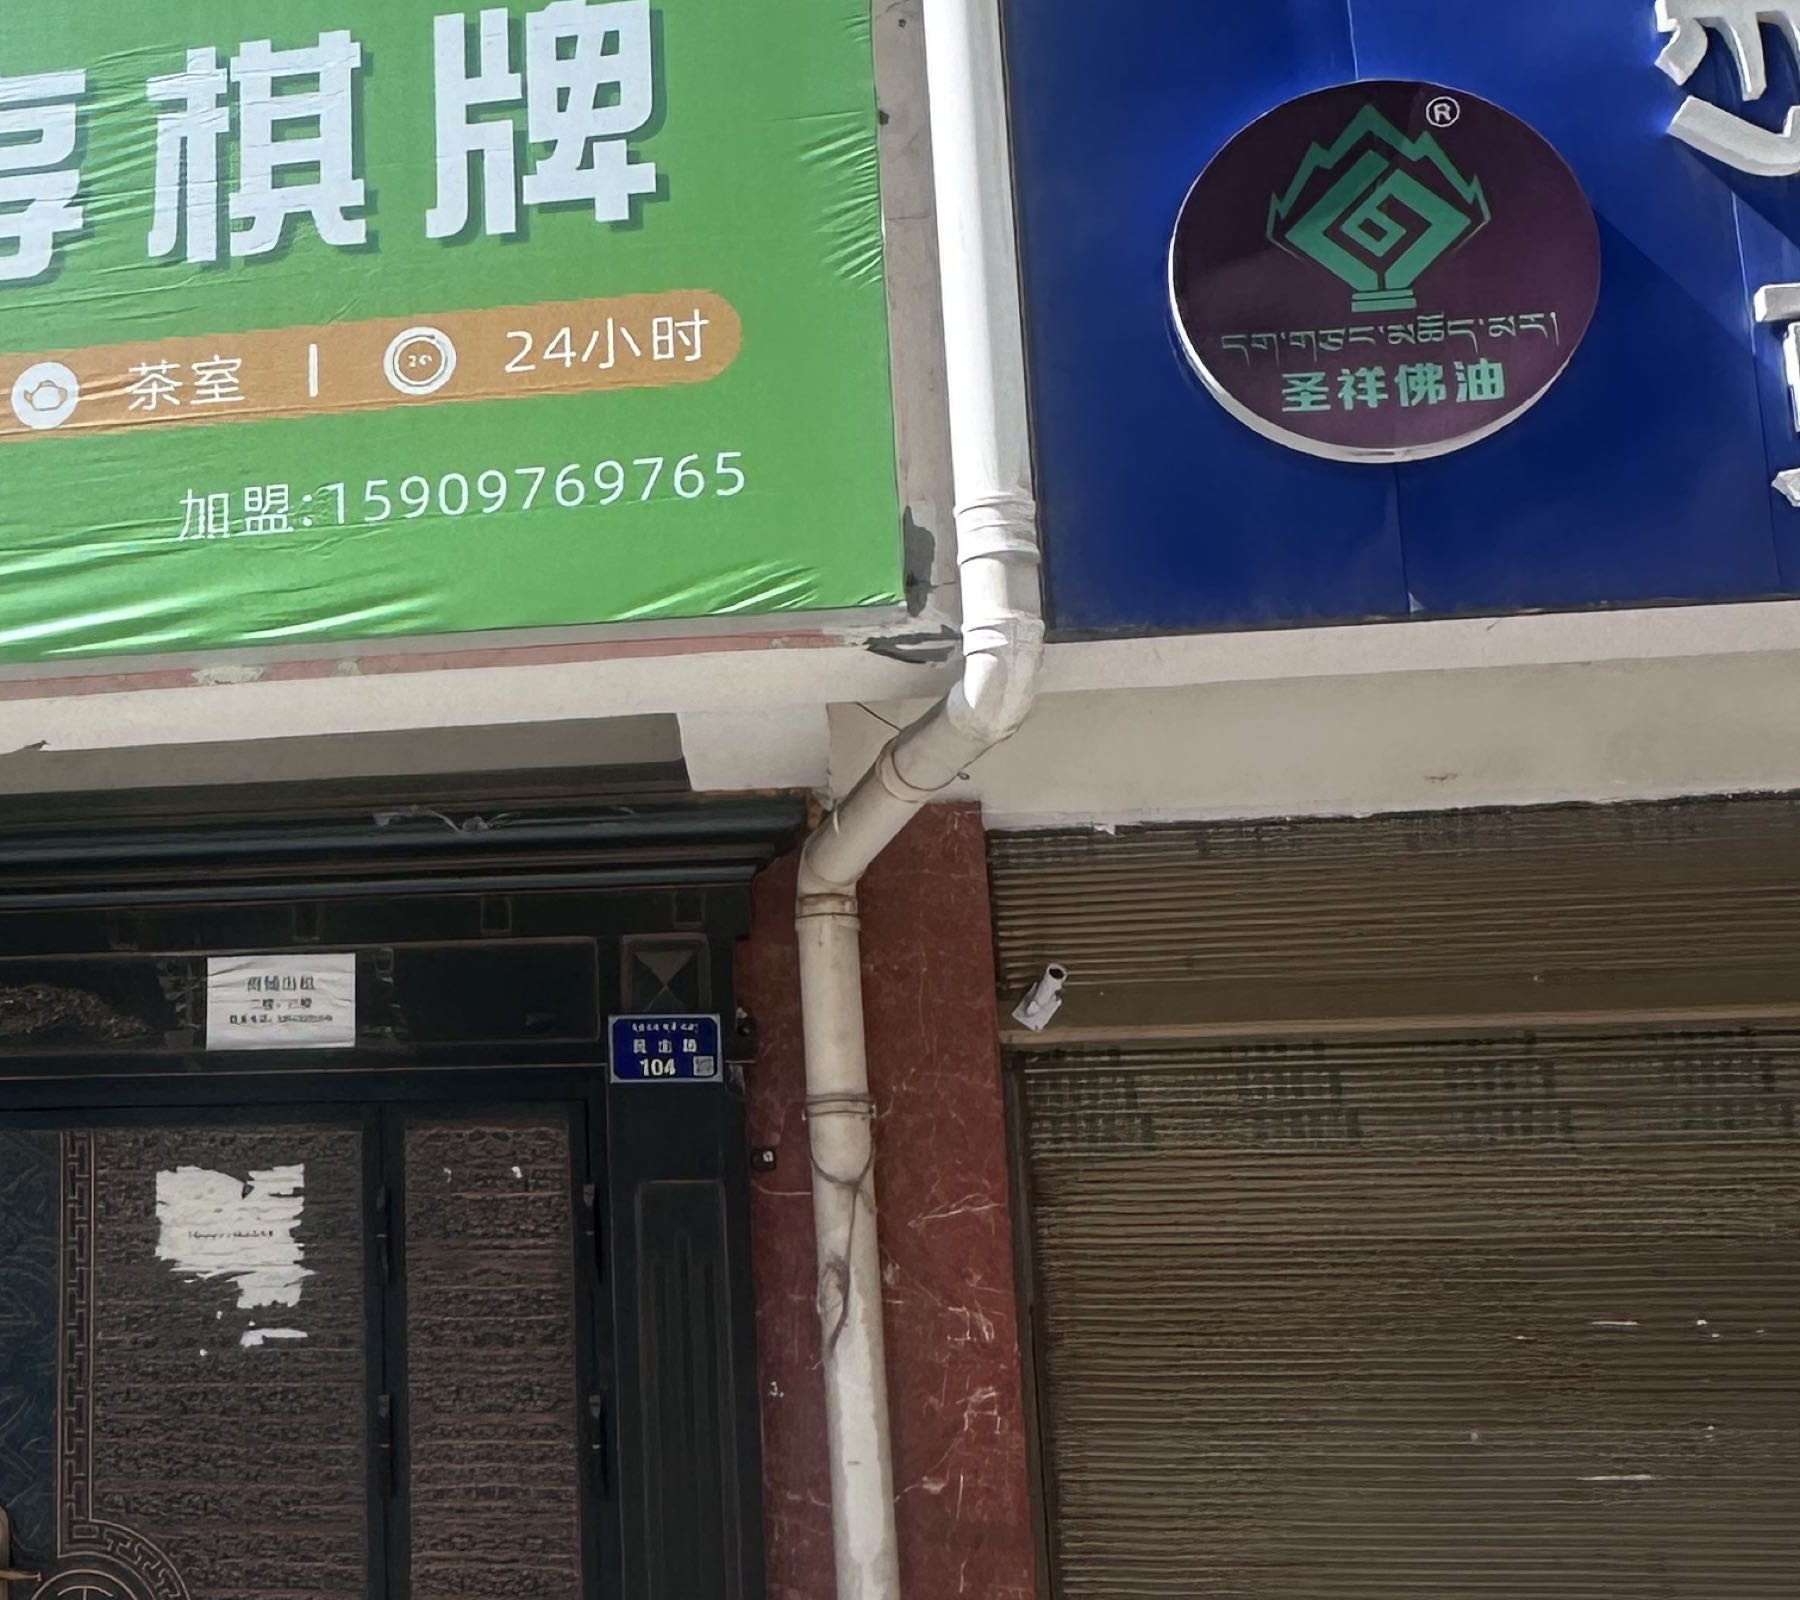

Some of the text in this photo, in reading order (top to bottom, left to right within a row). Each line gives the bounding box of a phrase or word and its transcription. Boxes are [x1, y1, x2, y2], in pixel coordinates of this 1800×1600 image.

[127, 353, 246, 412] 茶室
[504, 308, 712, 376] 24小时
[1281, 357, 1506, 413] 圣祥佛油
[178, 451, 749, 543] 加盟:15909769765
[640, 1058, 676, 1076] 104
